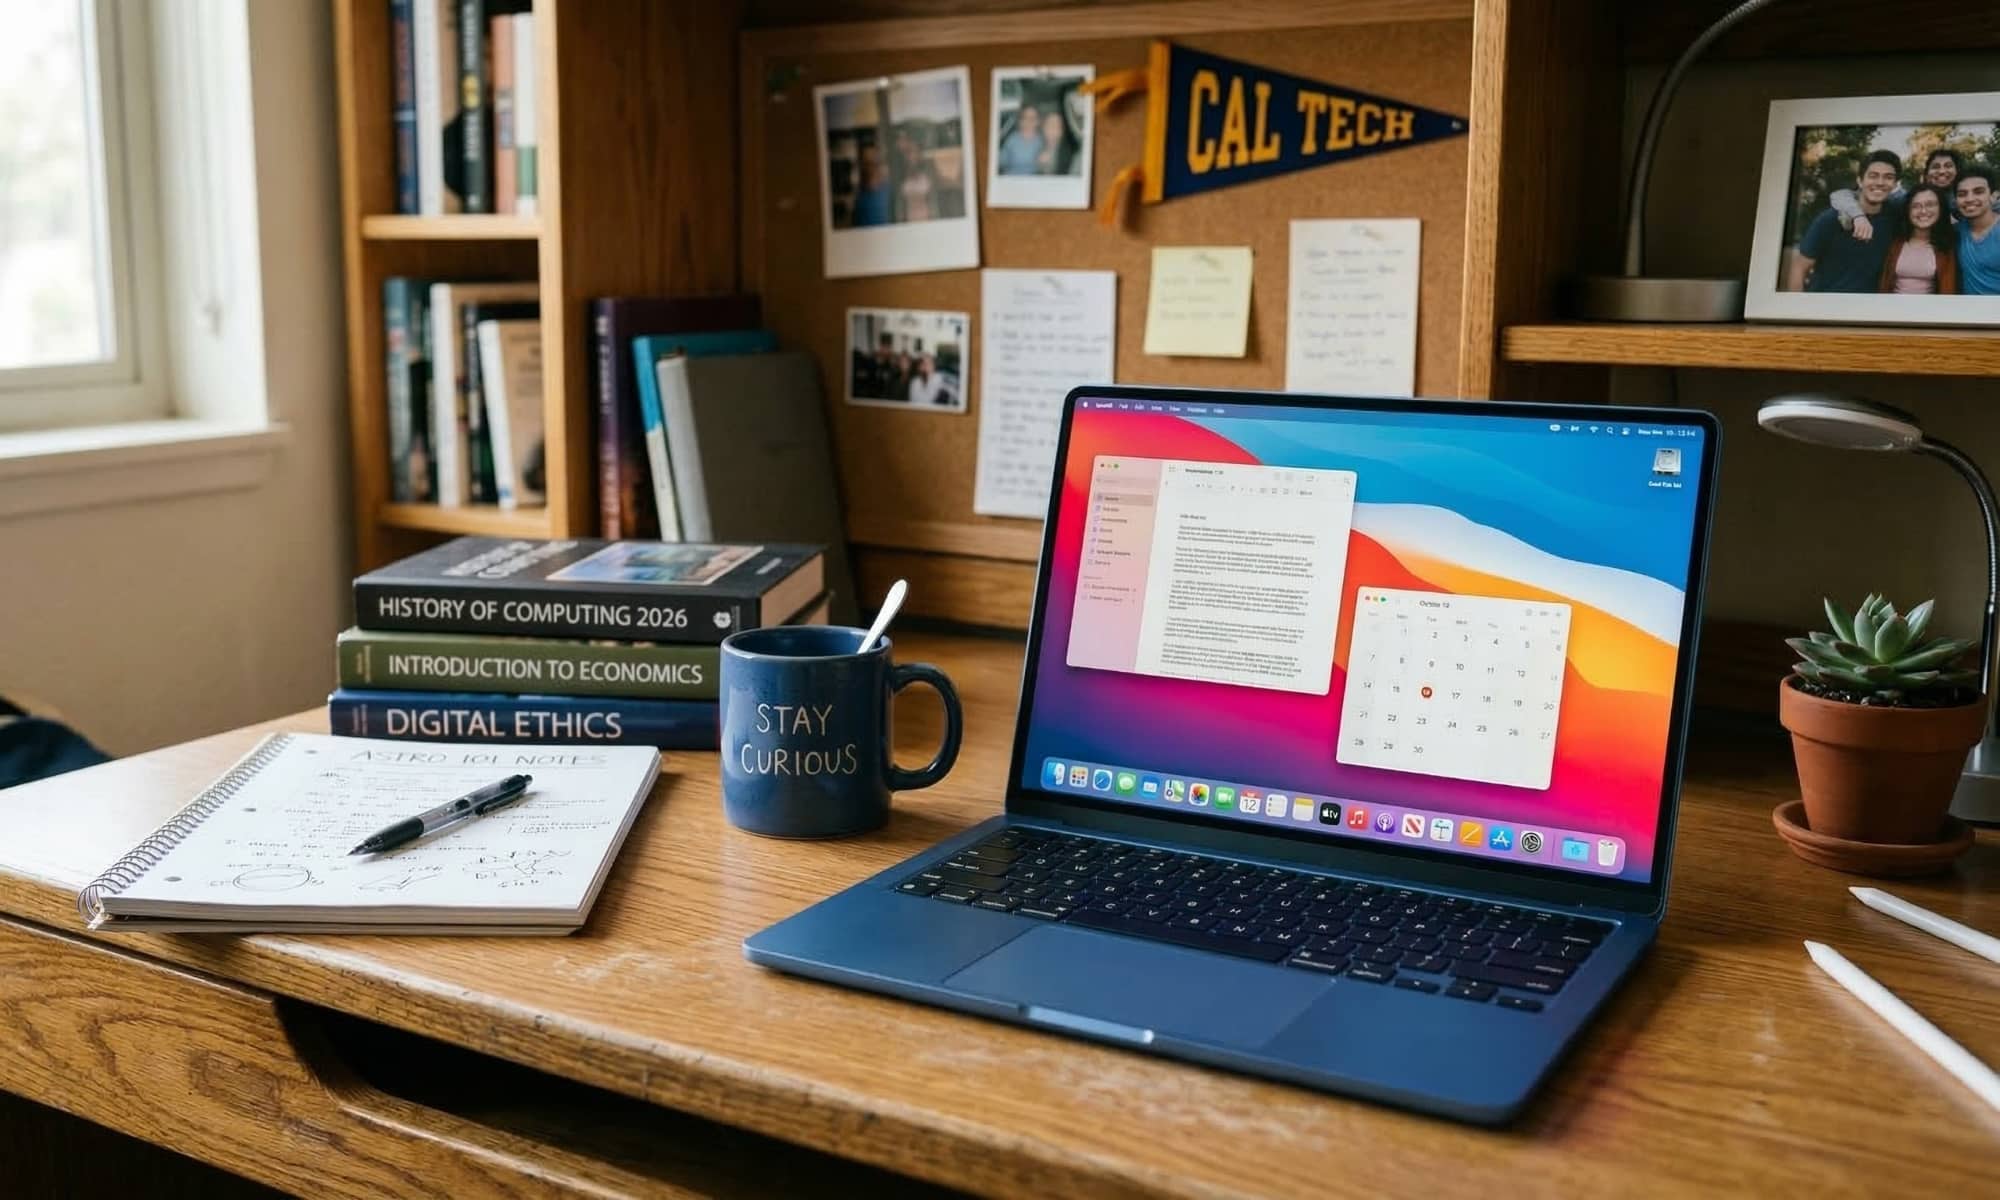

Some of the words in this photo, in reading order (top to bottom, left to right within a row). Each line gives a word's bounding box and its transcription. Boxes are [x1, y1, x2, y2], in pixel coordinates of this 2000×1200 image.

[1187, 69, 1281, 175] CAL
[1297, 88, 1416, 156] TECH
[380, 597, 465, 619] HISTORY
[475, 600, 497, 621] OF
[504, 602, 631, 626] COMPUTING
[637, 607, 687, 627] 2026
[390, 656, 541, 678] INTRODUCTION
[546, 660, 574, 680] TO
[580, 661, 702, 684] ECONOMICS
[387, 709, 504, 736] DIGITAL
[515, 711, 621, 738] ETHICS
[756, 703, 833, 736] STAY
[351, 749, 447, 763] ASTRO
[463, 754, 498, 765] 101
[516, 754, 608, 766] NOTES
[741, 743, 857, 776] CURIOUS
[1244, 799, 1256, 811] 12
[1328, 810, 1338, 818] tv
